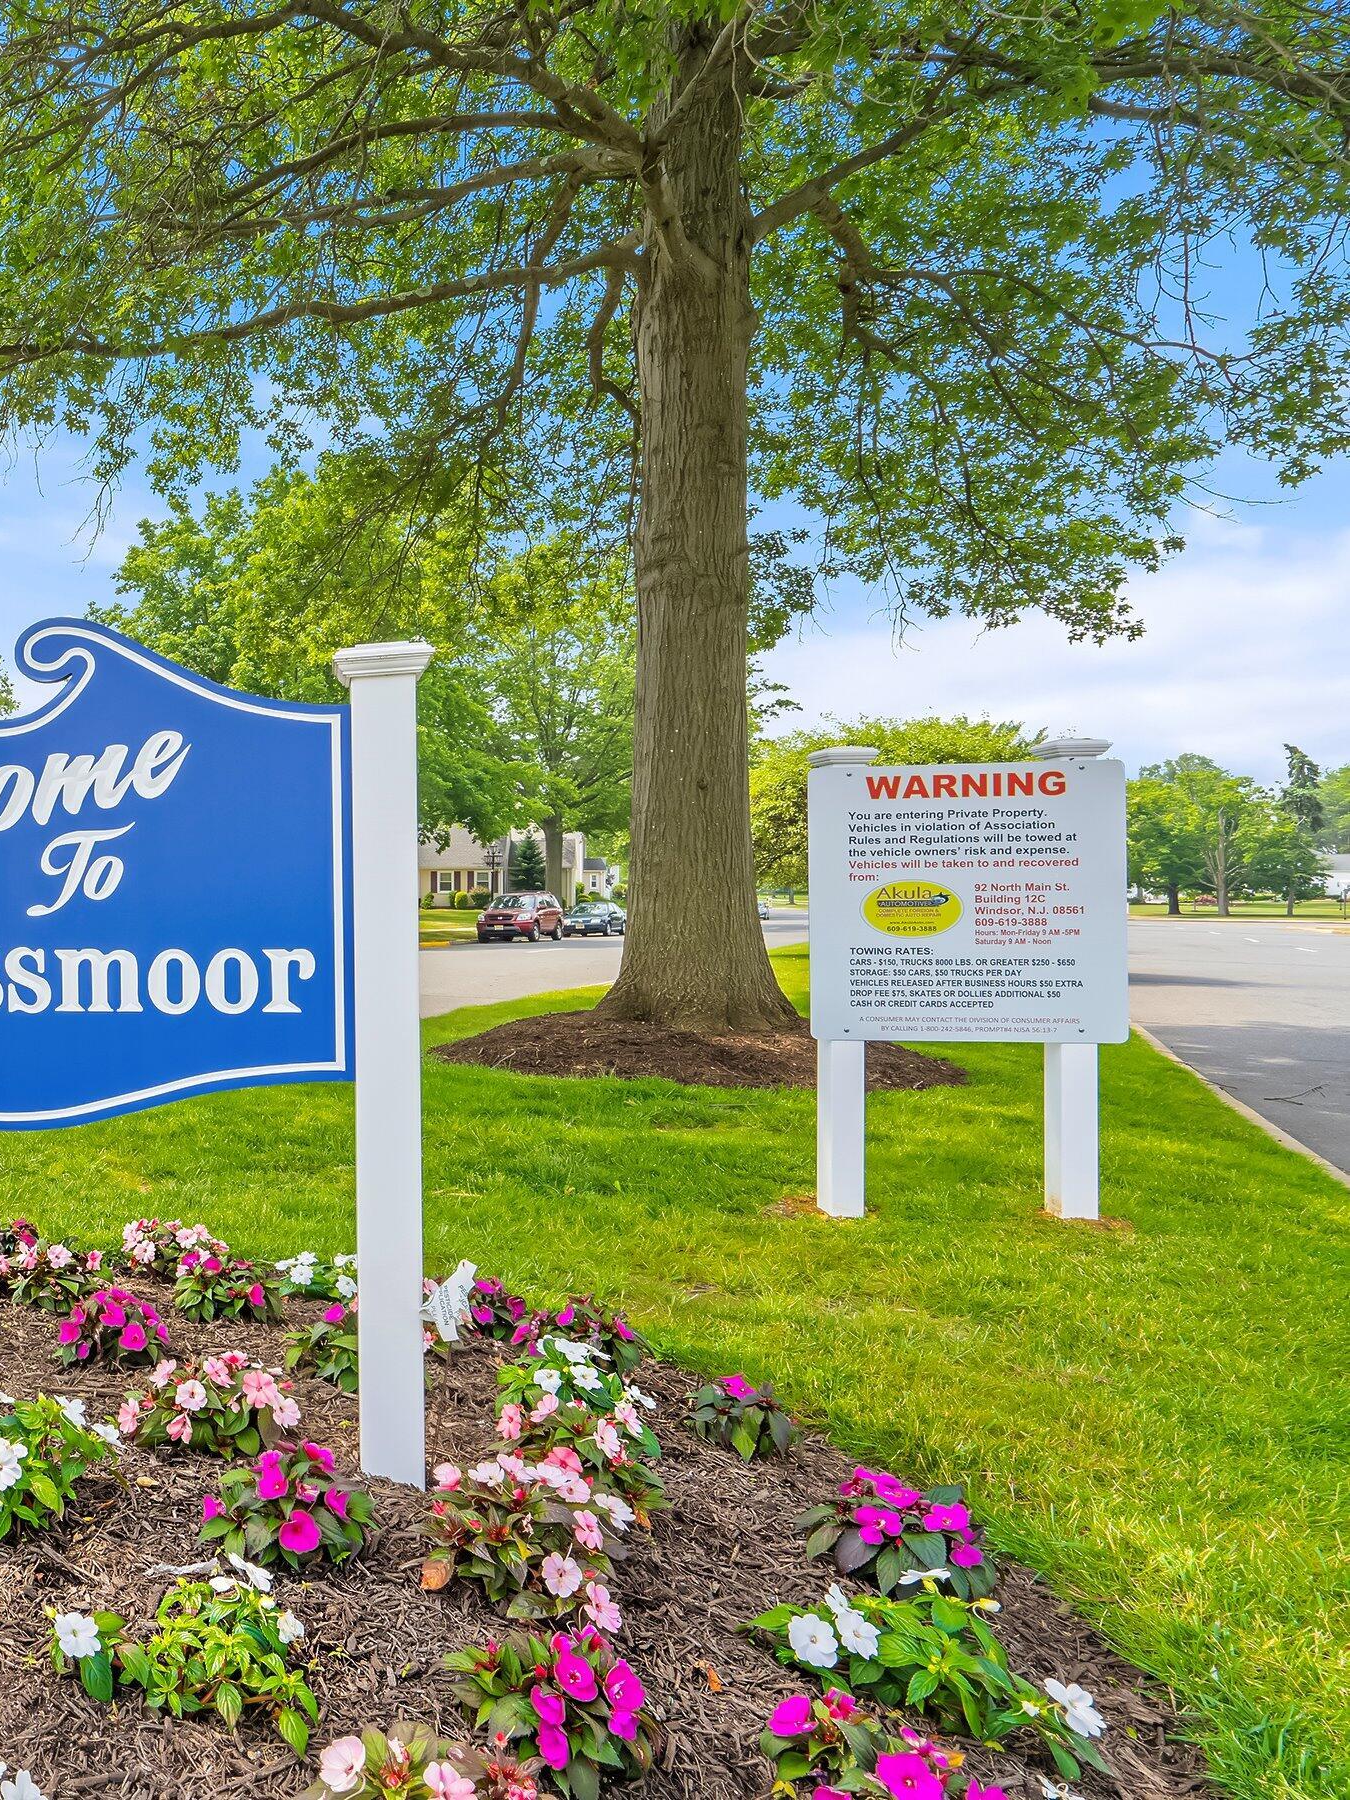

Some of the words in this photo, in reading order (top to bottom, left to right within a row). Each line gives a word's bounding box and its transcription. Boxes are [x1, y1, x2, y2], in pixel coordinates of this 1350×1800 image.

[866, 771, 1066, 799] WARNING
[849, 811, 871, 821] You
[874, 812, 892, 820] are
[896, 810, 944, 821] entering
[947, 809, 988, 819] Private
[992, 808, 1047, 819] Property.
[849, 823, 897, 833] Vehicles
[900, 822, 911, 832] in
[915, 822, 965, 832] violation
[969, 821, 981, 831] of
[984, 820, 1055, 830] Association
[849, 835, 881, 845] Rules
[885, 835, 906, 844] and
[910, 834, 980, 846] Regulations
[983, 833, 1003, 843] will
[1008, 833, 1021, 843] be
[1026, 833, 1062, 843] towed
[1066, 833, 1077, 842] at
[849, 848, 867, 857] the
[870, 848, 911, 857] vehicle
[965, 846, 986, 856] risk
[990, 846, 1012, 855] and
[1016, 846, 1070, 857] expense.
[849, 860, 897, 869] Vehicles
[901, 859, 921, 869] will
[924, 859, 938, 868] be
[942, 859, 974, 868] taken
[978, 859, 989, 868] to
[993, 858, 1015, 868] and
[1019, 858, 1079, 868] recovered
[27, 821, 135, 916] To
[849, 872, 879, 881] from:
[1025, 883, 1051, 891] Main
[1055, 883, 1070, 891] St.
[876, 886, 931, 899] Akula
[975, 895, 1021, 905] Building
[1025, 895, 1046, 903] 12C
[975, 907, 1024, 915] Windsor,
[1028, 906, 1049, 914] N.J.
[1053, 906, 1085, 914] 08561
[975, 918, 1048, 926] 609-619-3888
[1001, 929, 1040, 937] Mon-Friday
[975, 938, 1006, 946] Saturday
[909, 969, 933, 977] CARS,
[1040, 980, 1053, 988] $50
[1056, 980, 1084, 988] EXTRA
[958, 990, 993, 998] DOLLIES
[920, 1000, 948, 1008] CARDS
[950, 1000, 994, 1008] ACCEPTED
